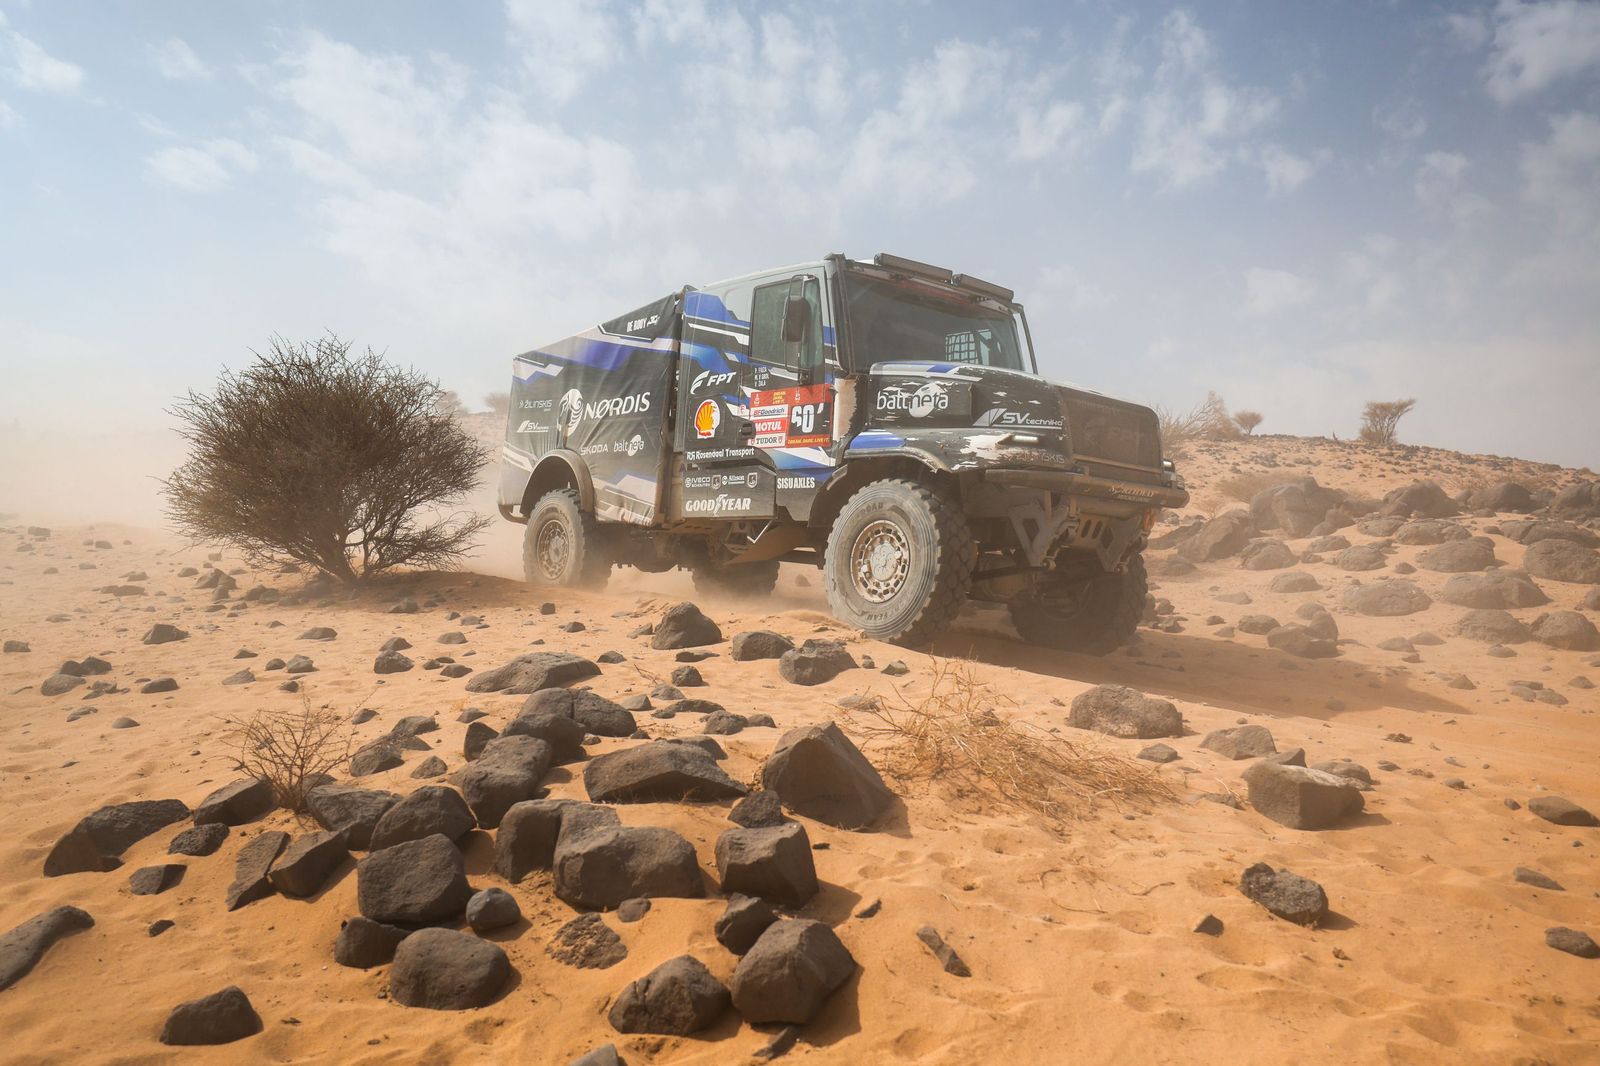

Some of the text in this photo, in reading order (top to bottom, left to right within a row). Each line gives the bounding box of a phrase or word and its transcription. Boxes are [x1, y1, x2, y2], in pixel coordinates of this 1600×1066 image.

[706, 371, 737, 386] FPT
[584, 392, 650, 420] NØRDIS
[755, 421, 782, 432] MOTUL
[756, 436, 778, 444] TUDOR
[725, 448, 755, 458] Transport
[685, 496, 751, 512] GOODYEAR
